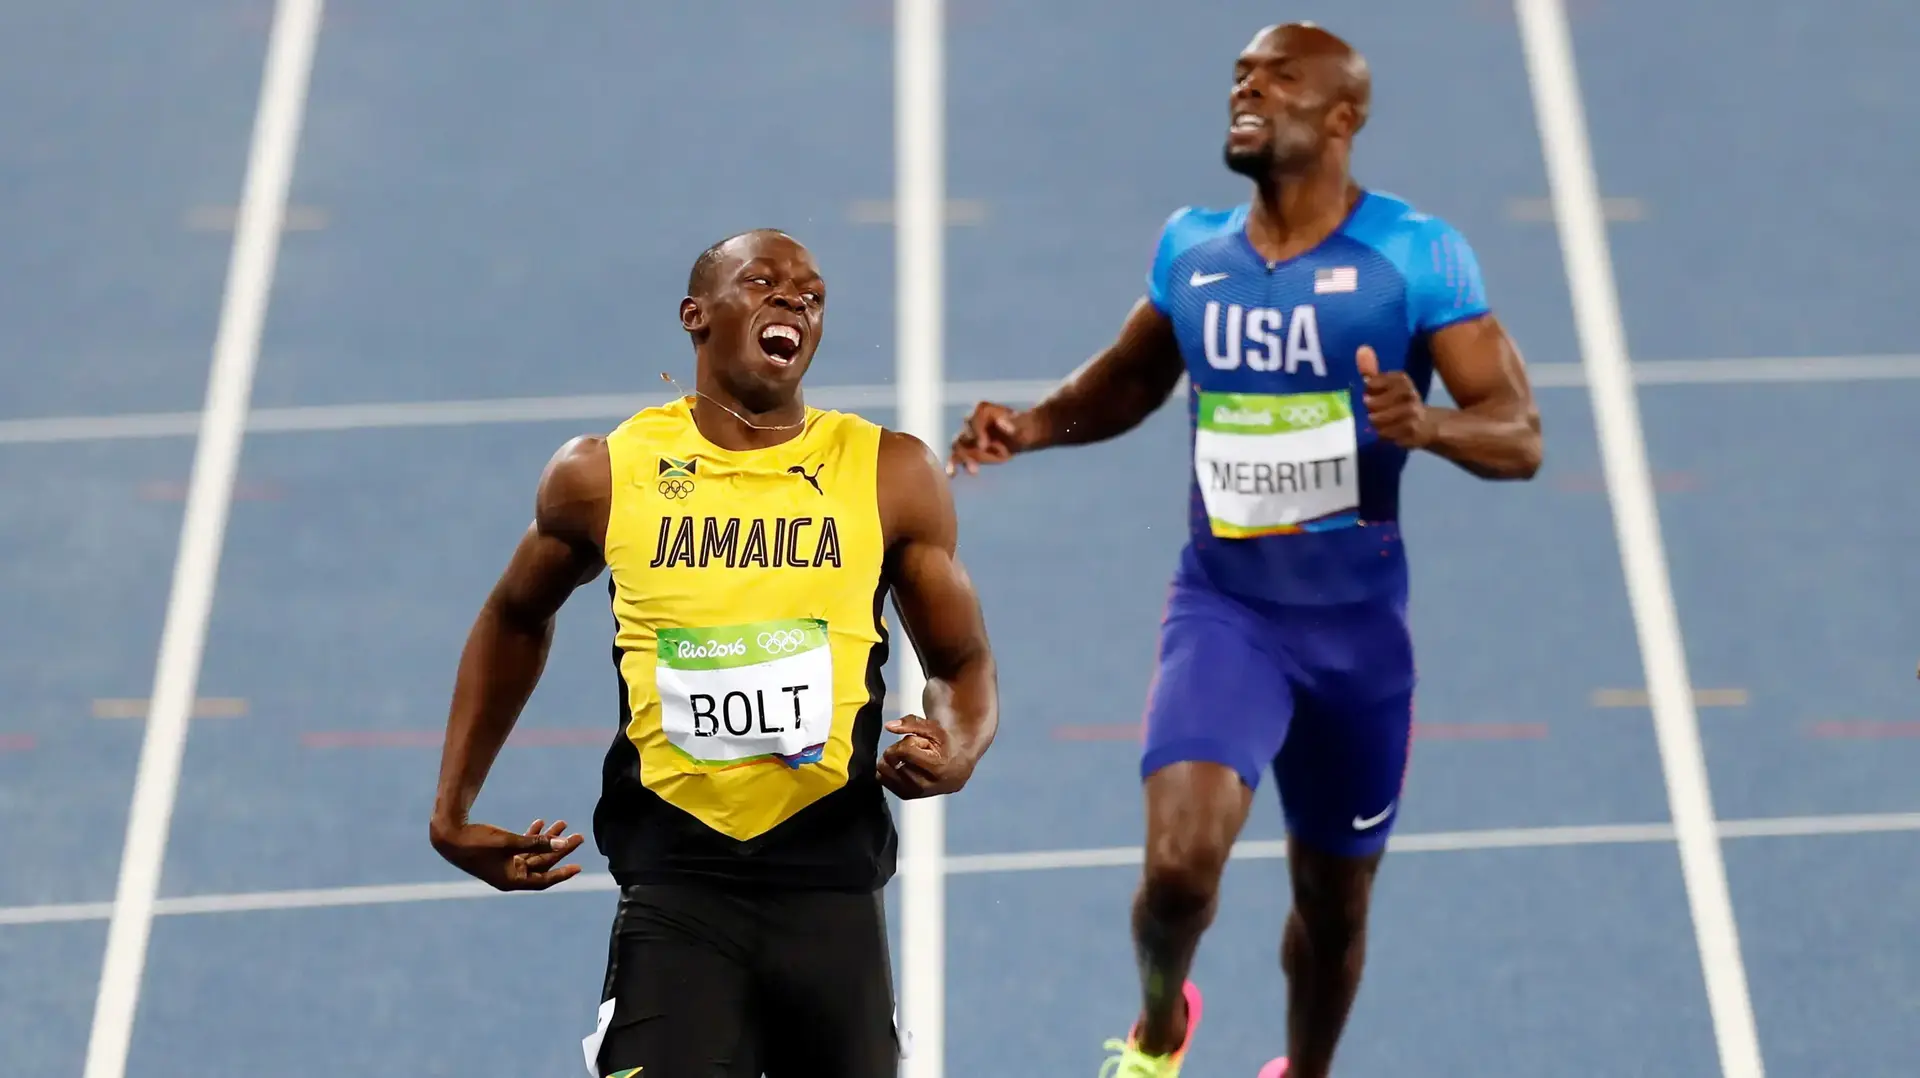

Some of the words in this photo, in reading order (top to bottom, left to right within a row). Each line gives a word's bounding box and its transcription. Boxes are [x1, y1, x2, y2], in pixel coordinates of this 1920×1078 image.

[1203, 300, 1328, 378] USA
[1211, 456, 1348, 495] MERRITT
[649, 516, 842, 569] JAMAICA
[689, 684, 810, 738] BOLT
